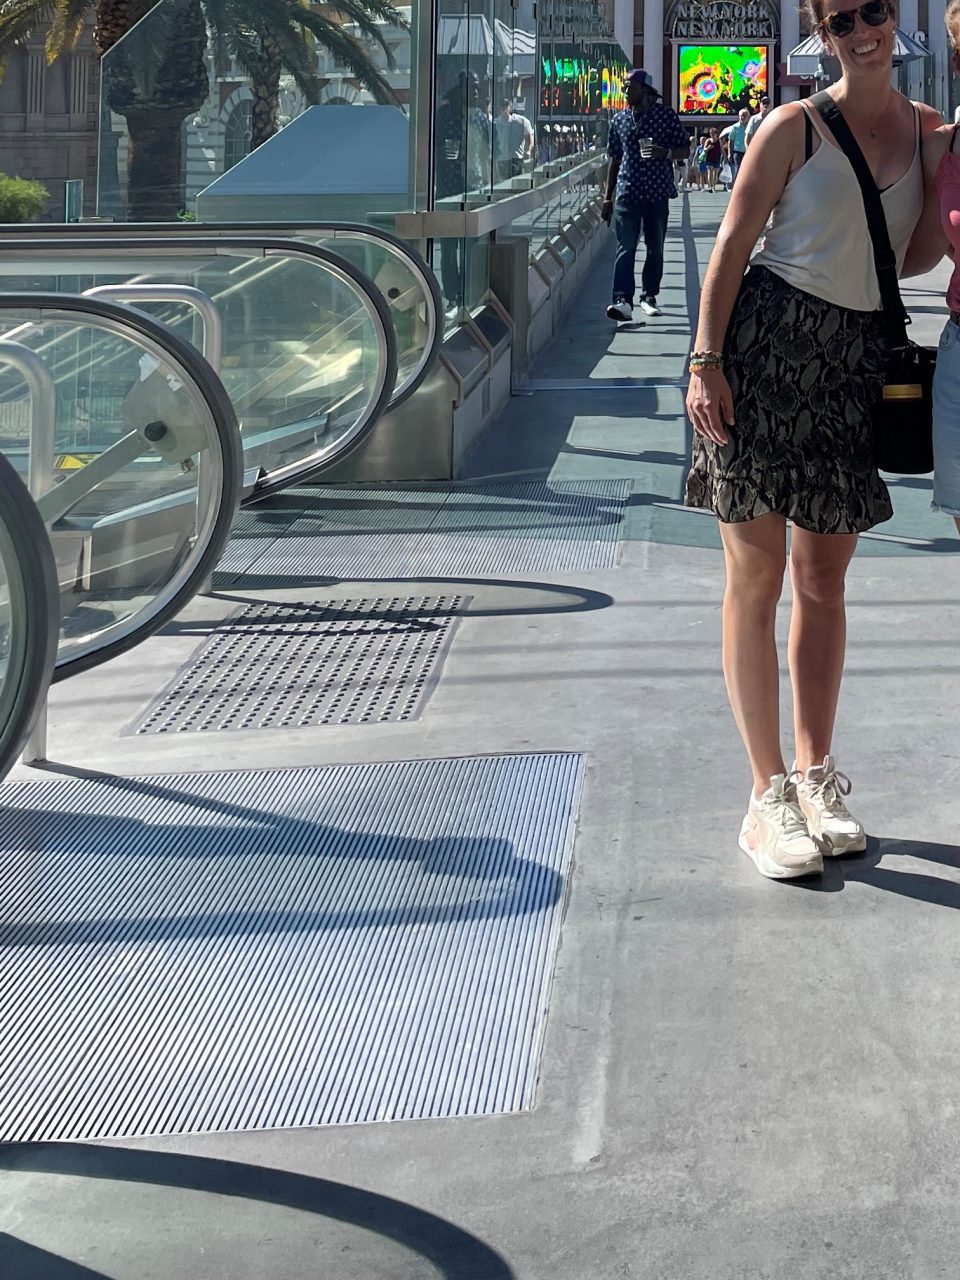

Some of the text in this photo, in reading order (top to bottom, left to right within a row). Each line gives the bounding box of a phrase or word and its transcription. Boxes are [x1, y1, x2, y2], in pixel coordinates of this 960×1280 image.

[677, 4, 770, 19] NEW YORK
[677, 21, 770, 37] NEW YORK
